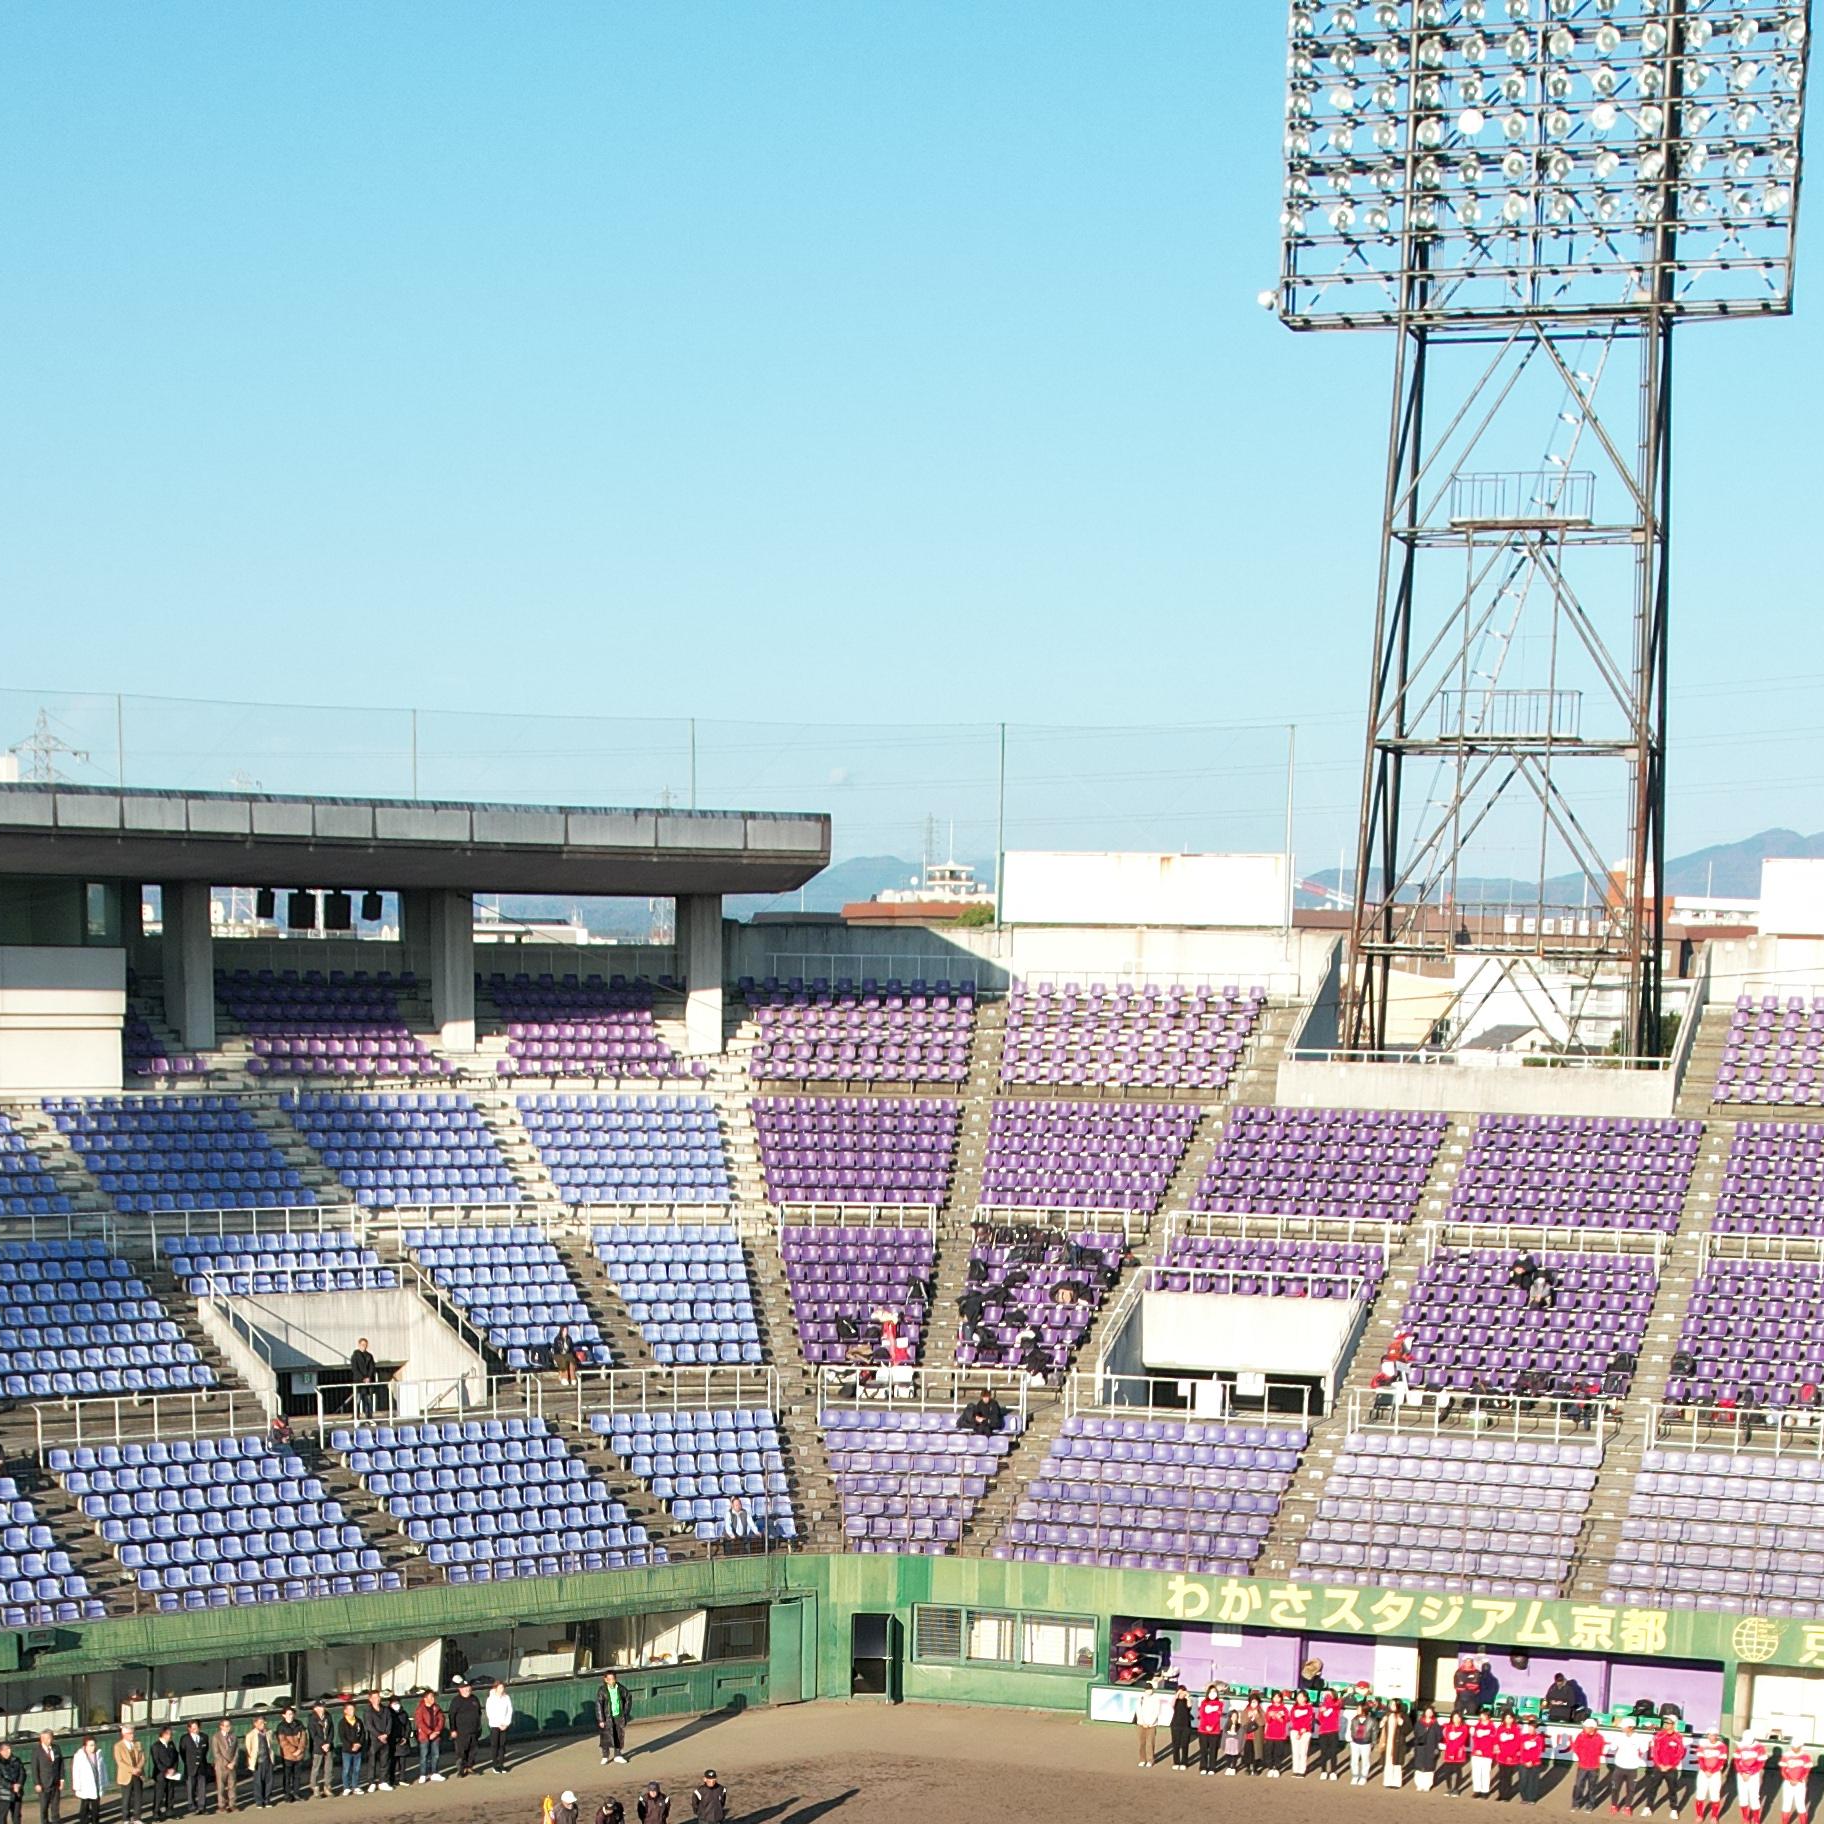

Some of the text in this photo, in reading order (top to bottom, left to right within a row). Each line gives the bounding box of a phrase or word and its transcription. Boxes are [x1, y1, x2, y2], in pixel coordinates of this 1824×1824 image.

[1166, 1575, 1668, 1654] わかさスタジアム京都
